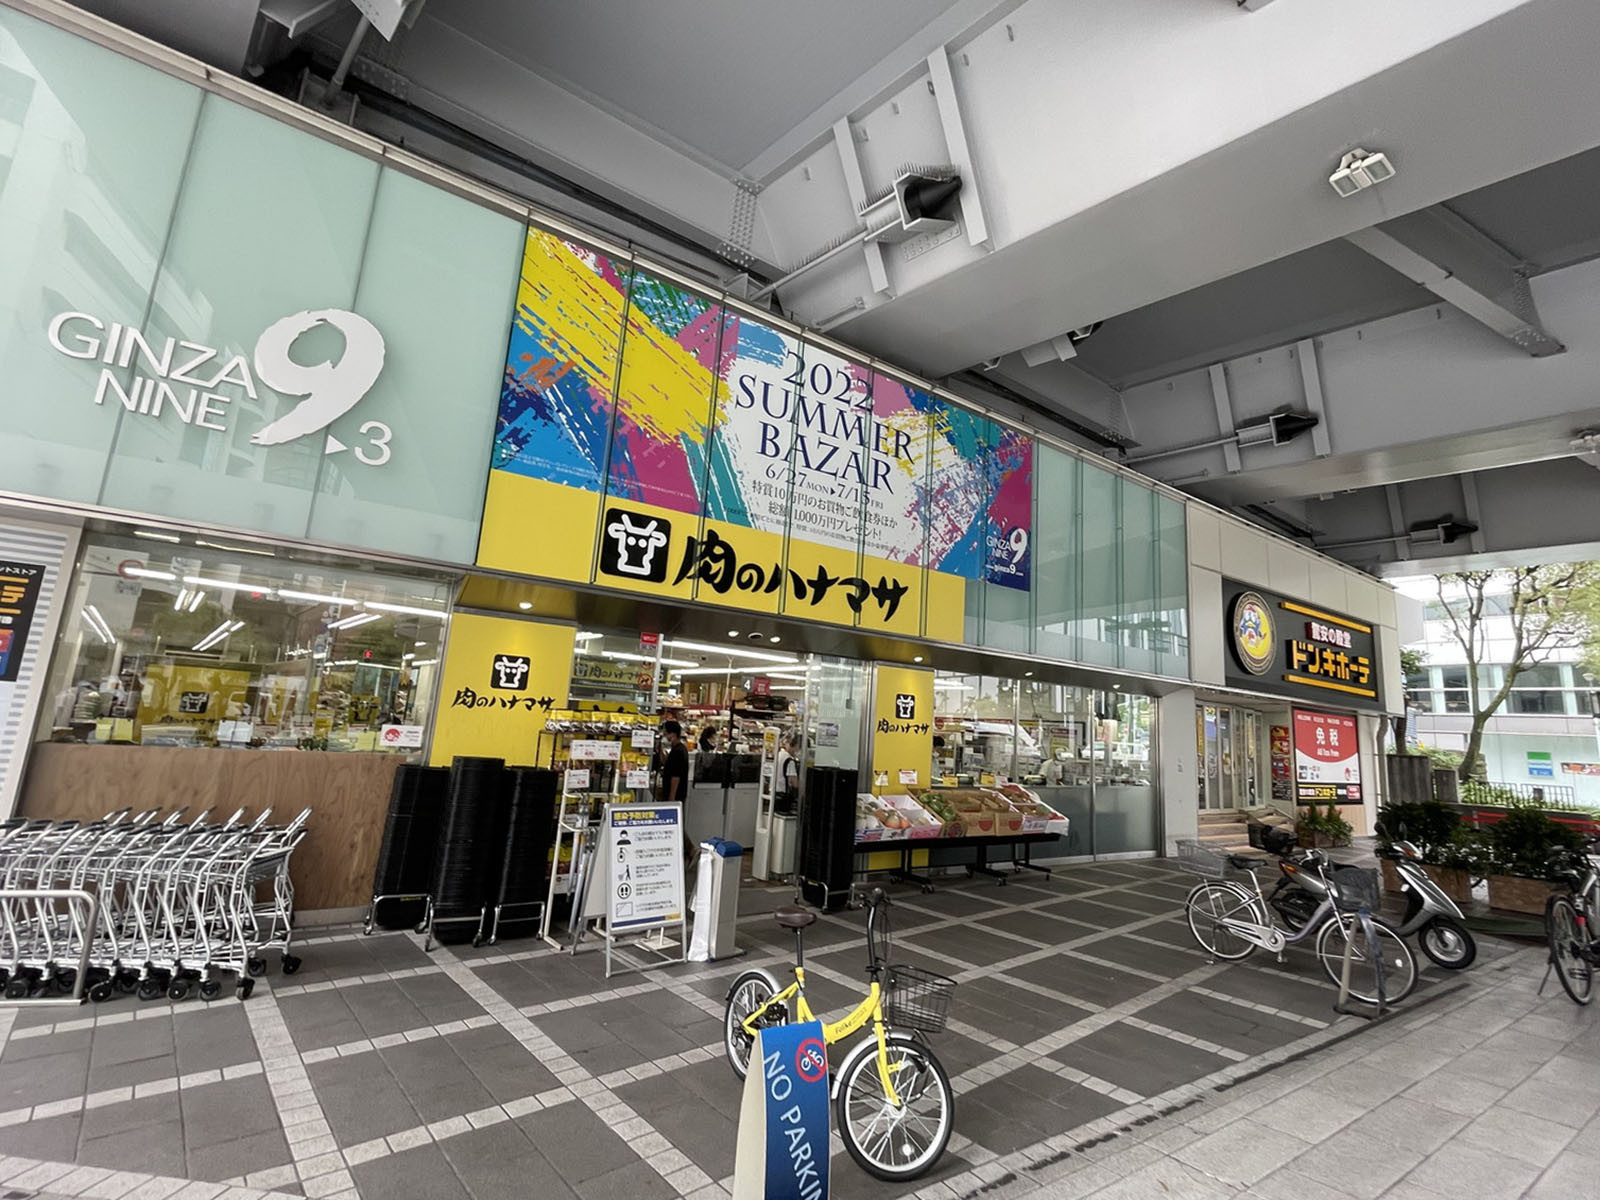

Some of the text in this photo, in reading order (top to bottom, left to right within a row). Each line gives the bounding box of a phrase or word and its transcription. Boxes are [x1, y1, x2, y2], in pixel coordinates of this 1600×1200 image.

[48, 310, 260, 399] GINZA
[250, 308, 386, 446] 9
[784, 350, 873, 412] 2022
[94, 368, 232, 432] NINE
[735, 374, 914, 465] SUMMER
[353, 421, 392, 466] 3
[756, 420, 894, 495] BAZAR
[765, 463, 807, 488] 6/27
[806, 481, 831, 495] MON
[871, 499, 884, 510] FRI
[986, 535, 1012, 552] GINZA
[1009, 528, 1028, 564] 9
[672, 529, 909, 622] 肉のハナマサ
[451, 686, 556, 713] 肉のハナマサ
[876, 718, 930, 735] 肉のハナマサ
[763, 1050, 793, 1101] NO
